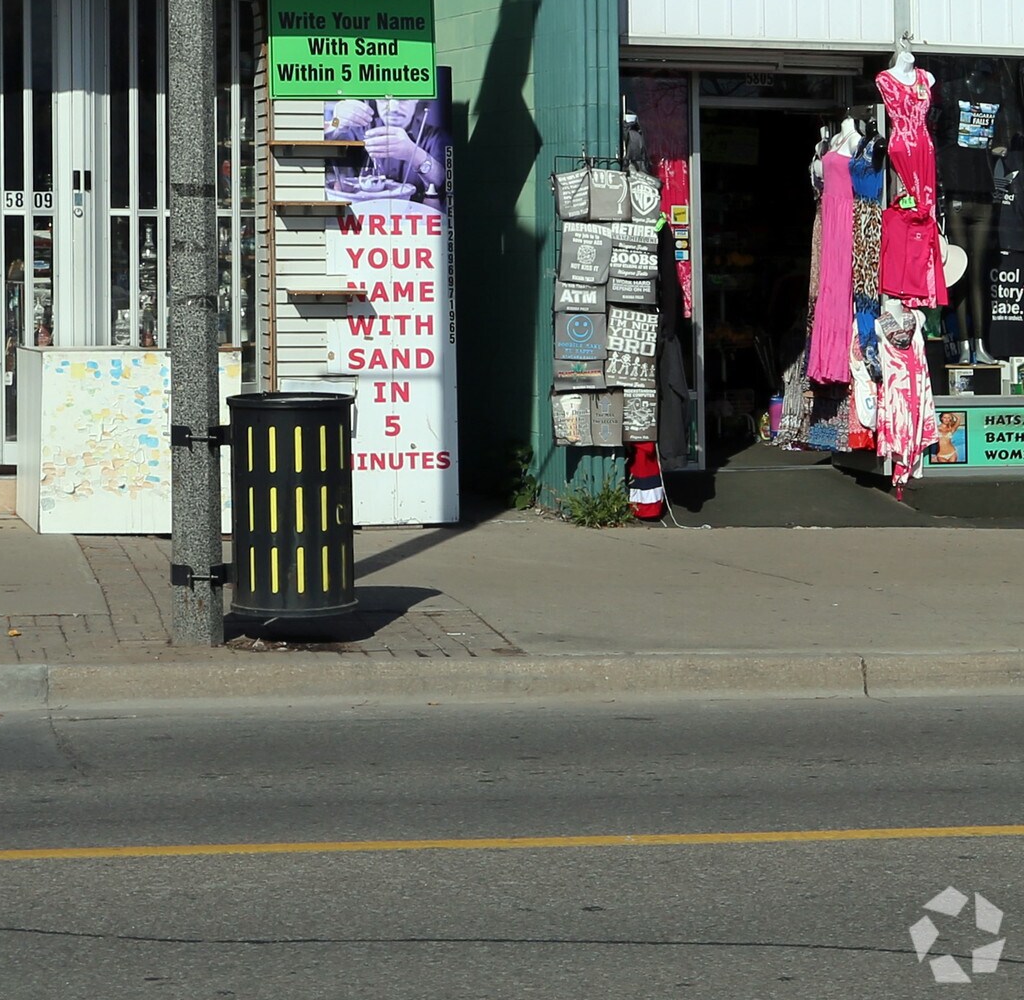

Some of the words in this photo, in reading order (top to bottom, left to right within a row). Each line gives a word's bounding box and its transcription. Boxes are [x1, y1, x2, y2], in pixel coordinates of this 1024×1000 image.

[278, 11, 326, 30] Write
[332, 12, 370, 30] Your
[377, 12, 426, 30] Name
[308, 38, 348, 56] With
[354, 38, 398, 56] Sand
[277, 64, 334, 82] Within
[342, 64, 352, 82] 5
[359, 64, 430, 82] Minutes
[336, 214, 442, 236] WRITE
[346, 248, 434, 269] YOUR
[990, 268, 1020, 282] Cool
[560, 289, 597, 304] ATM
[610, 318, 626, 328] I'M
[632, 320, 658, 332] NOT
[612, 308, 658, 324] DUDE
[347, 315, 434, 336] WITH
[608, 326, 657, 342] YOUR
[606, 336, 656, 356] BRO
[348, 348, 434, 370] SAND
[374, 382, 410, 402] IN
[385, 416, 401, 436] 5
[985, 415, 1024, 426] HATS
[350, 452, 451, 470] INUTES
[985, 449, 1024, 460] WOM
